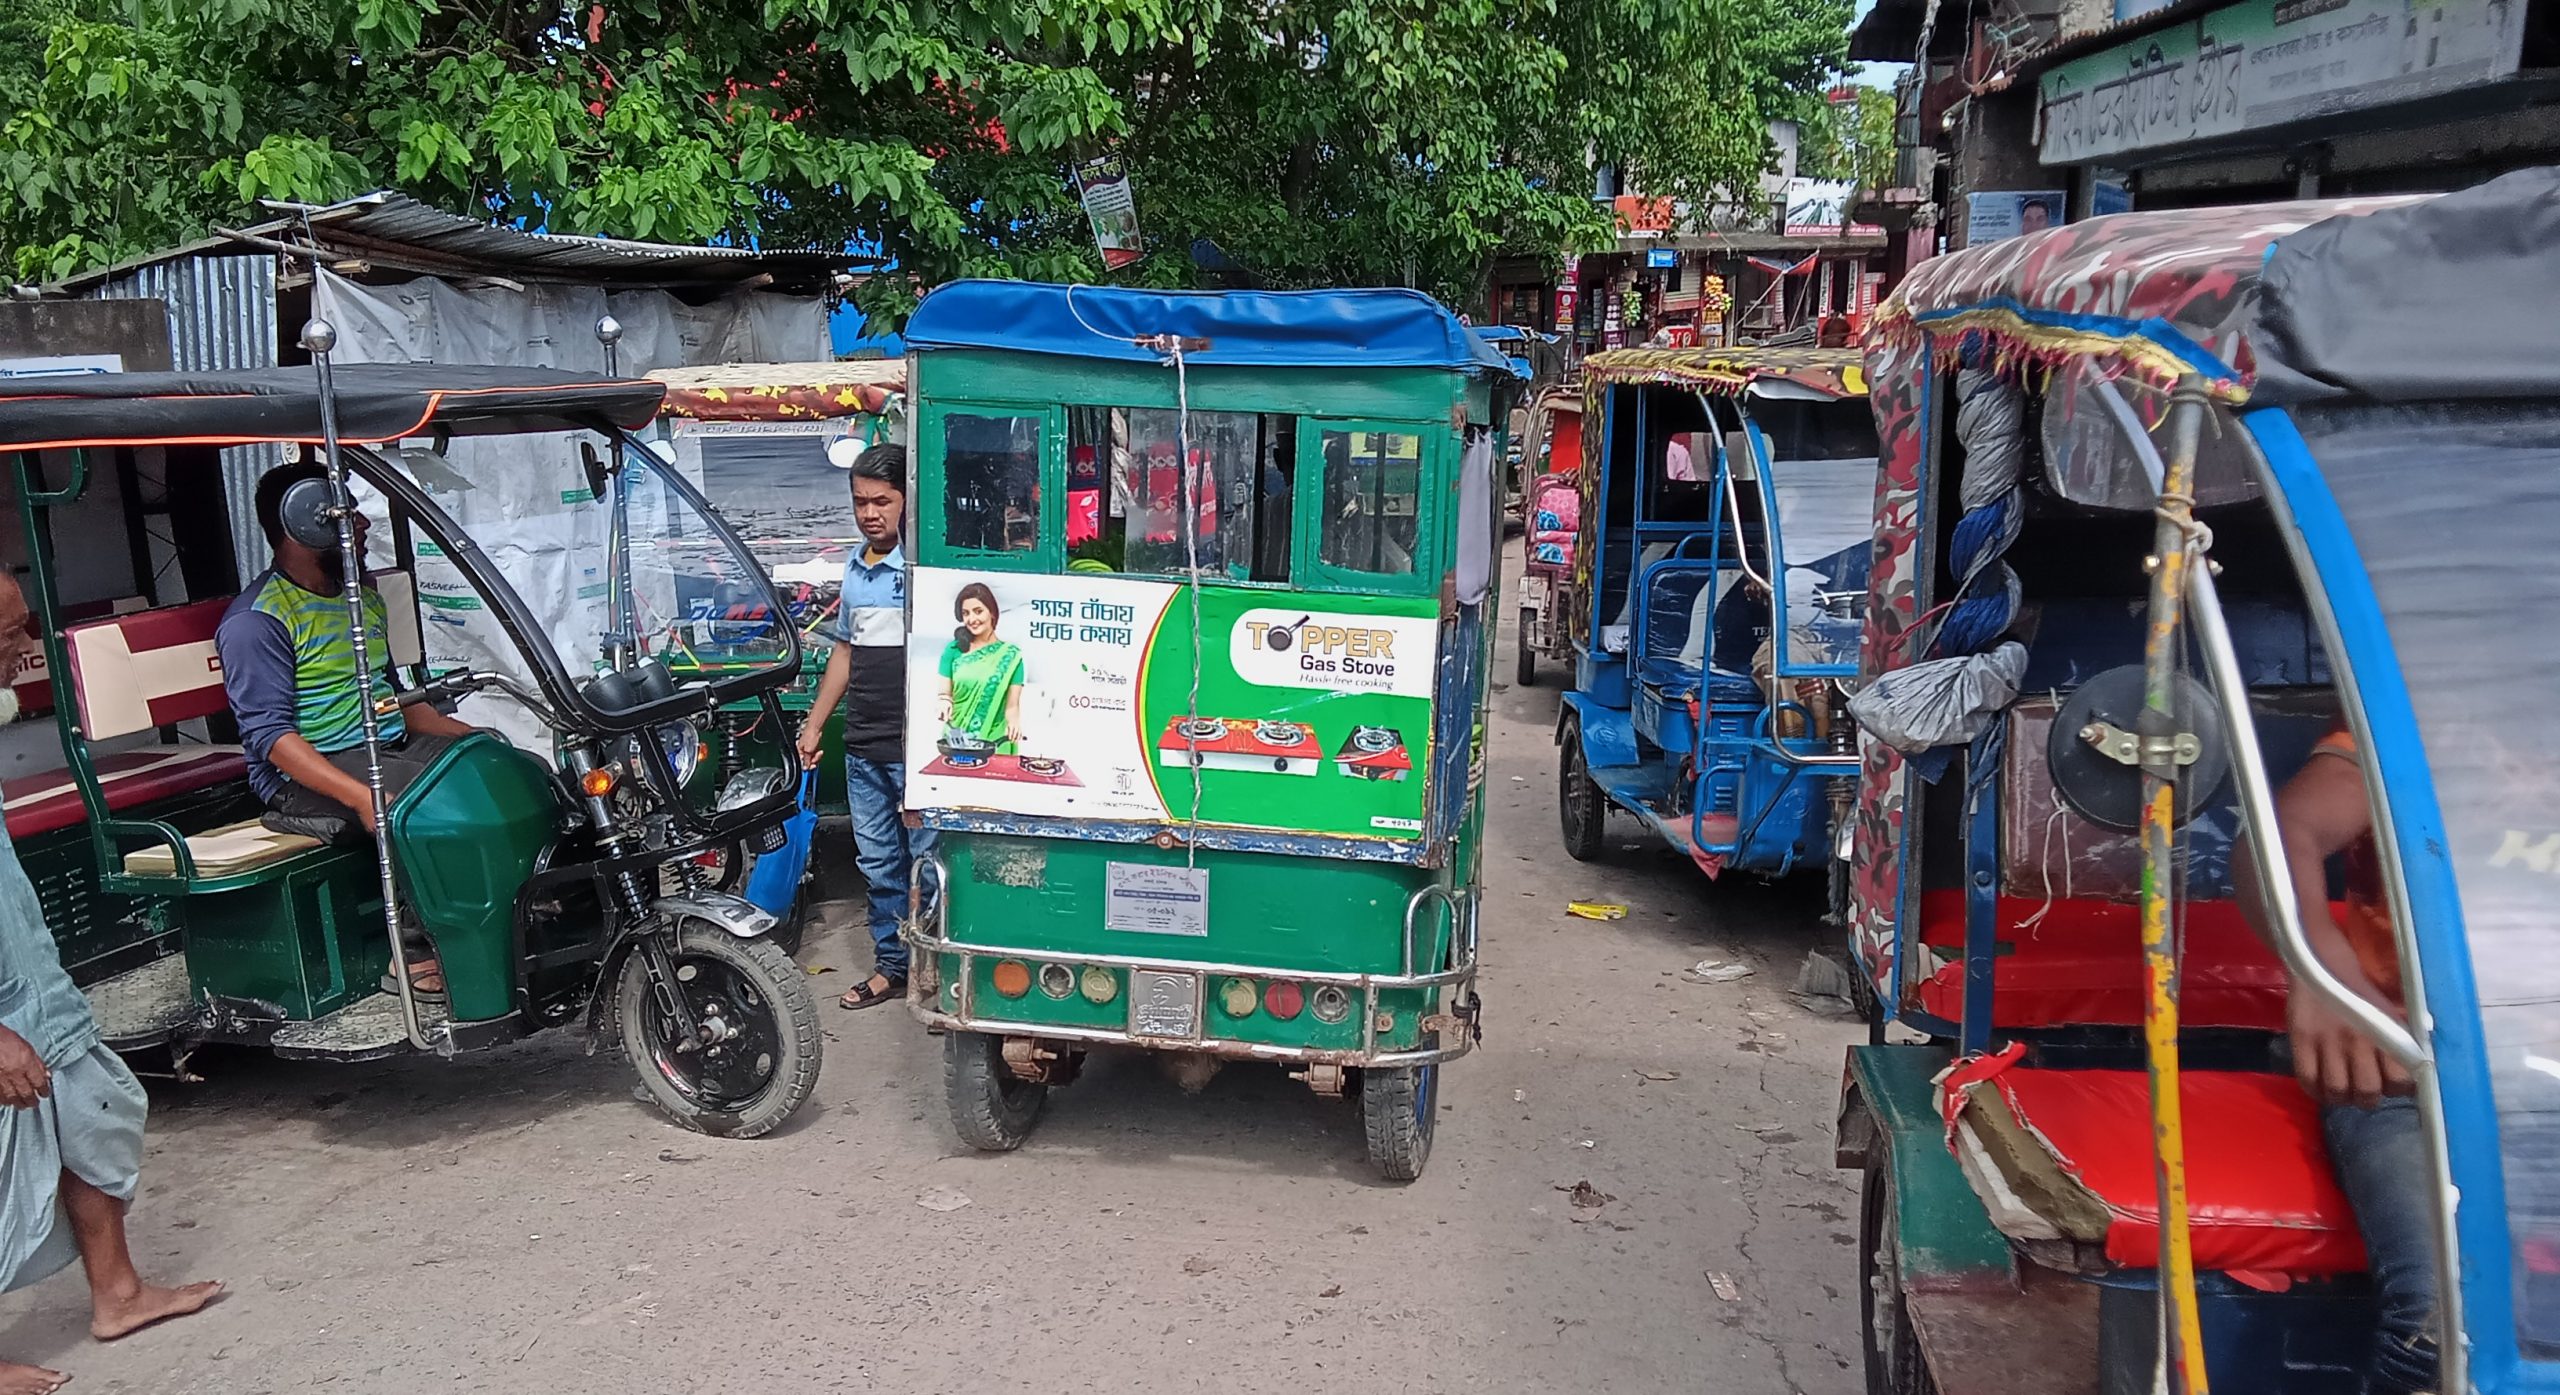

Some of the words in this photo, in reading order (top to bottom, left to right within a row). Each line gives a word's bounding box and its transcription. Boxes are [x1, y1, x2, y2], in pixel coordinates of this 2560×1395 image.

[1031, 599, 1074, 618] গ্যাস
[1080, 598, 1135, 625] বাঁচায়
[1030, 621, 1074, 642] খরচ
[1080, 625, 1133, 648] কমায়
[1300, 654, 1336, 672] Gas
[1342, 657, 1395, 677] Stove
[1355, 675, 1394, 691] cooking
